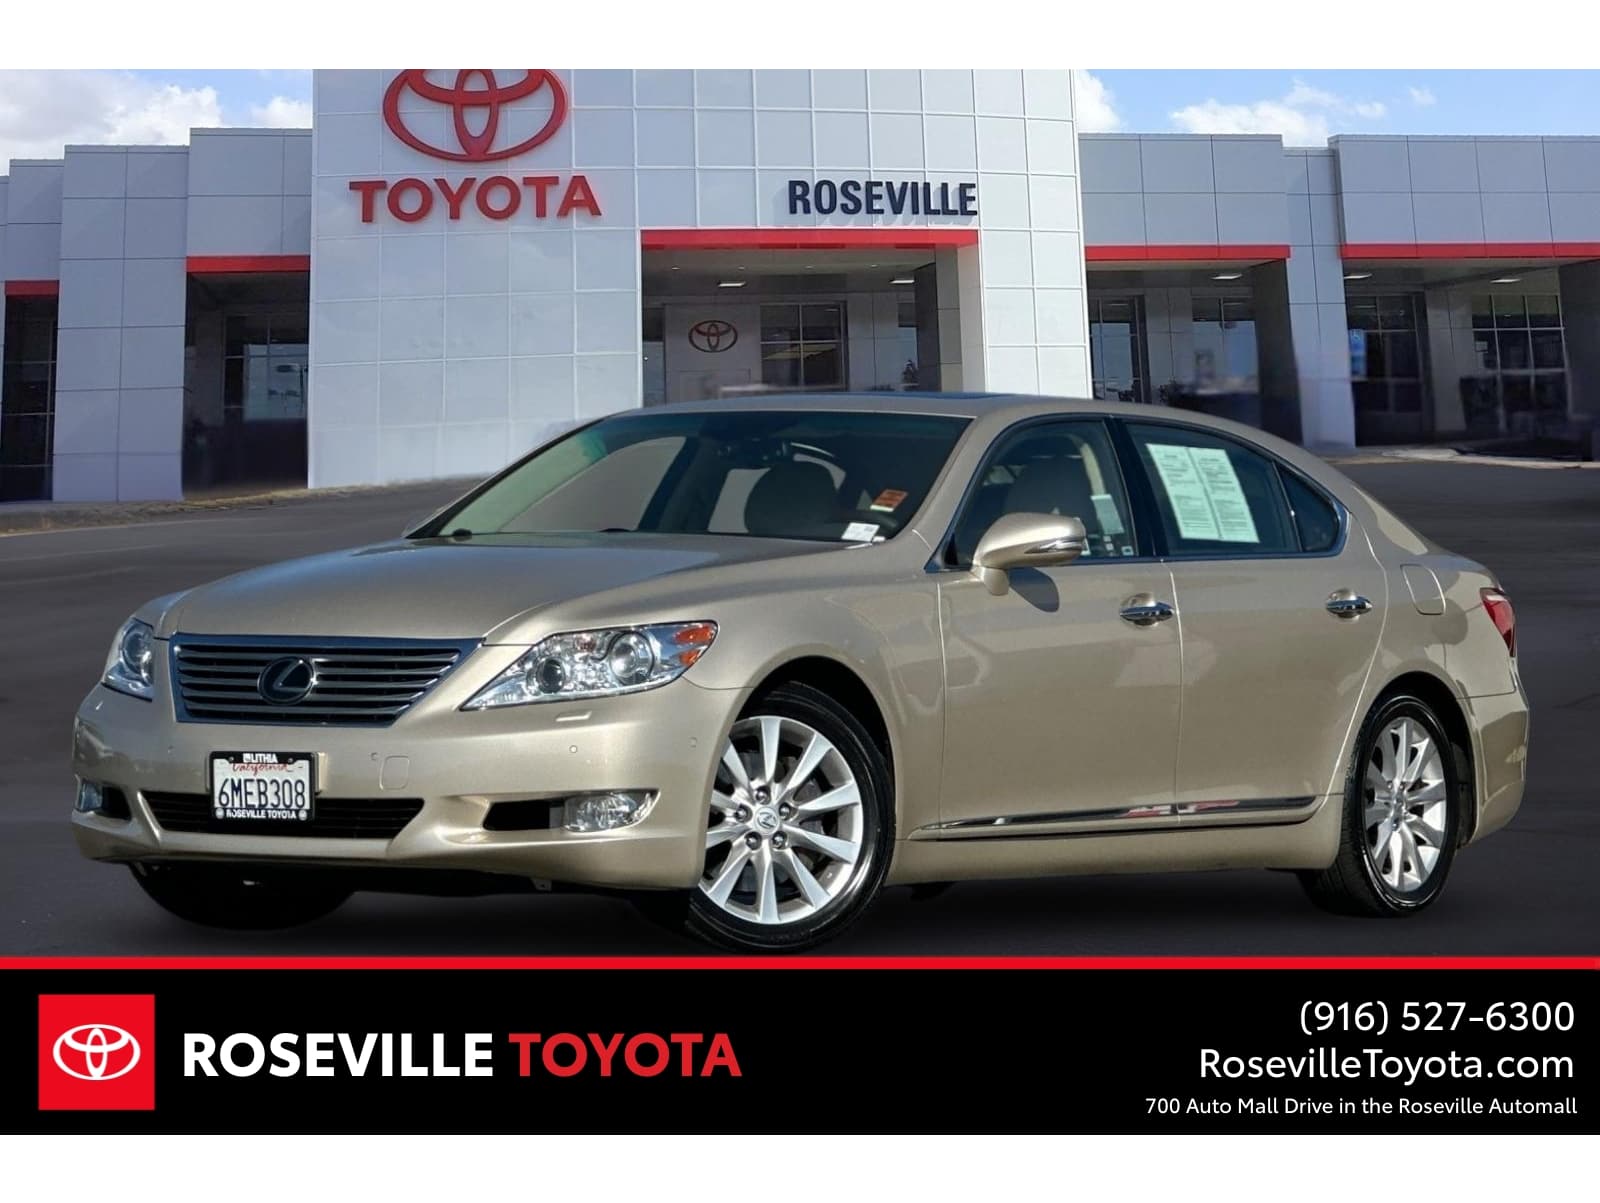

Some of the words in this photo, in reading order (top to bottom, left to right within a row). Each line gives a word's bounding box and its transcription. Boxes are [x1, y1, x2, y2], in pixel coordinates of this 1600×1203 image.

[349, 175, 602, 223] TOYOTA
[788, 180, 978, 216] ROSEVILLE
[251, 753, 278, 763] LITHIA
[219, 778, 305, 808] 6MEB308
[226, 809, 266, 818] ROSEVILLE
[267, 810, 297, 819] TOYOTA
